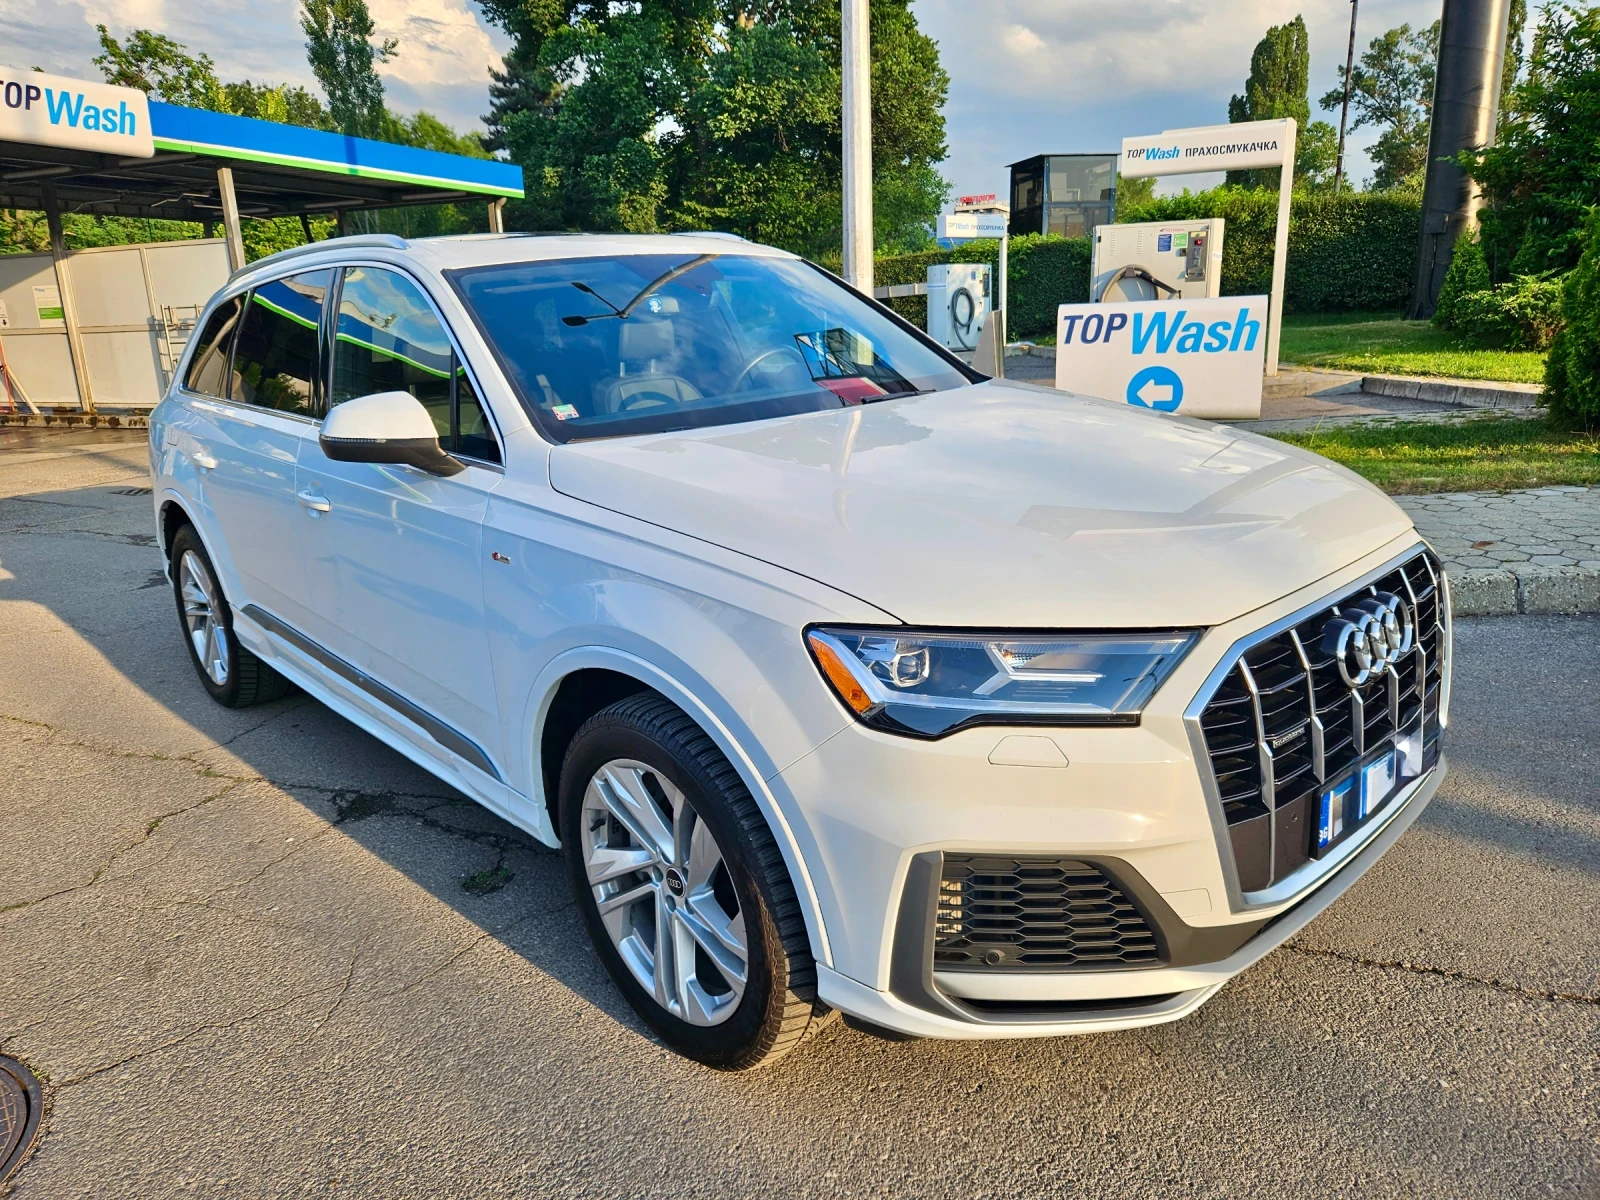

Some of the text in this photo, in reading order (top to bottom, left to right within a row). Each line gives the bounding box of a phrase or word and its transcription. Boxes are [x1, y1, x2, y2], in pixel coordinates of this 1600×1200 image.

[44, 87, 136, 136] Wash
[1127, 140, 1278, 161] TOP Wash ПРАХОСМУКАЧКА
[1063, 307, 1261, 355] TOP Wash
